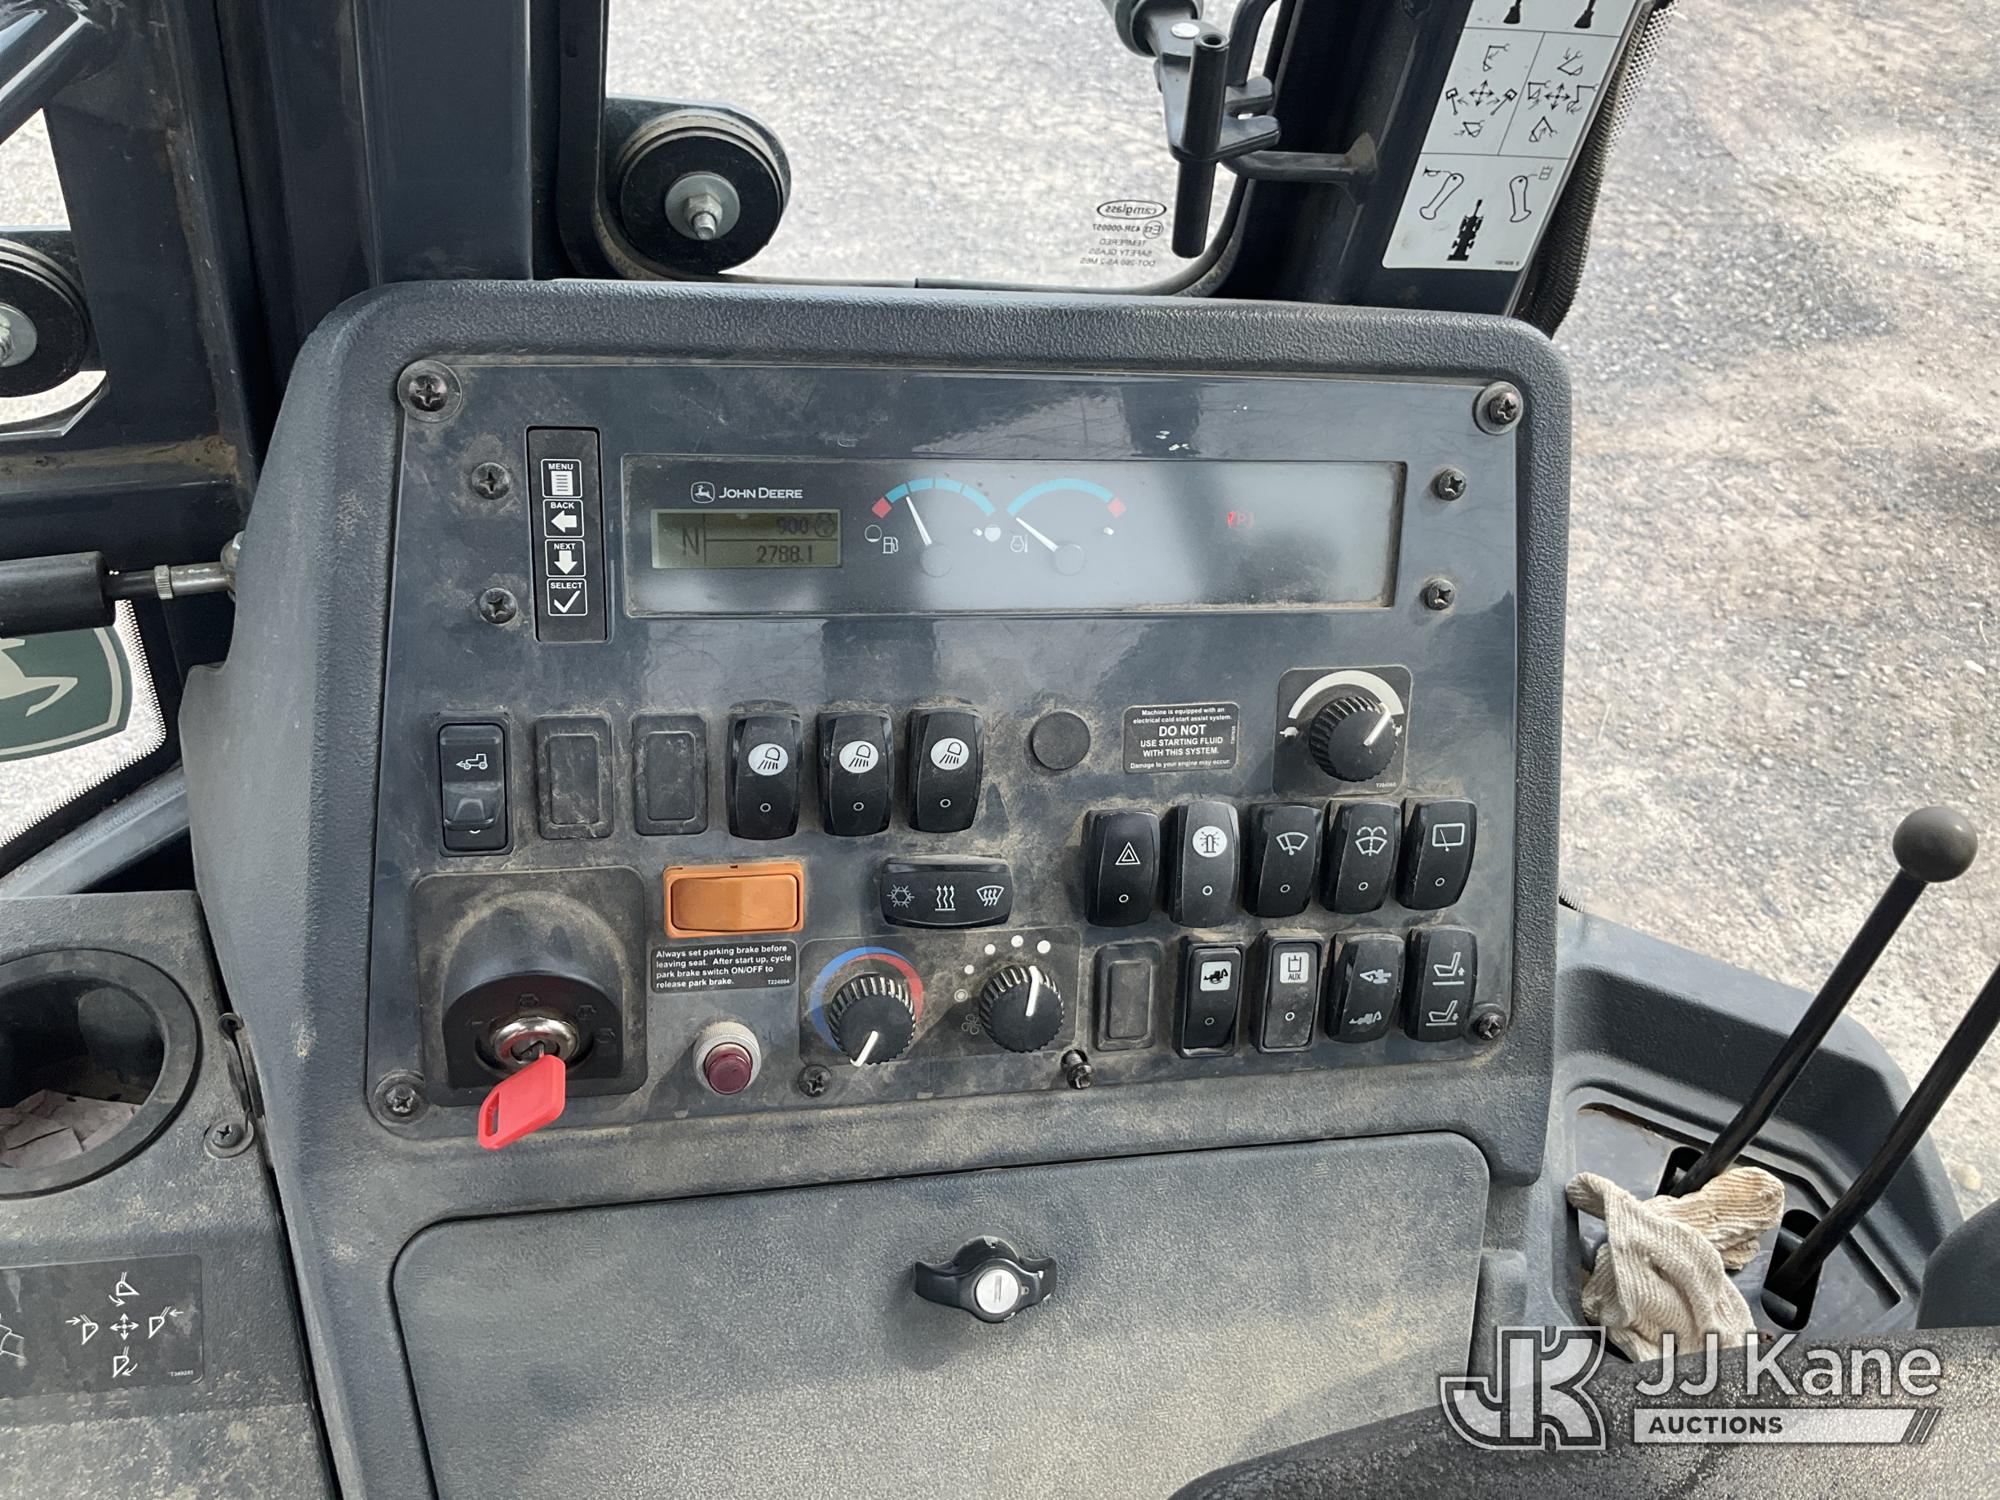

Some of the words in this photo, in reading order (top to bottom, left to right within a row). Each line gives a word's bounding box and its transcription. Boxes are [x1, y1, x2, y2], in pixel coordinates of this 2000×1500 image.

[718, 487, 758, 499] JOHN
[759, 487, 803, 499] DEERE
[682, 527, 699, 555] N
[756, 545, 813, 564] 2788.1
[1174, 708, 1202, 716] equipped
[1209, 714, 1232, 722] system.
[1158, 725, 1177, 737] DO
[1180, 724, 1207, 736] NOT
[1140, 740, 1157, 748] USE
[1158, 738, 1198, 747] STARTING
[1199, 736, 1223, 745] FLUID
[1142, 749, 1164, 757] WITH
[1165, 748, 1183, 756] THIS
[1185, 747, 1219, 755] SYSTEM.
[656, 950, 686, 959] Always
[688, 949, 702, 957] set
[703, 948, 734, 958] parking
[736, 946, 759, 954] brake
[761, 945, 787, 953] before
[656, 960, 687, 969] leaving
[688, 959, 708, 967] seat.
[712, 957, 733, 965] After
[756, 957, 769, 965] up,
[770, 954, 792, 963] cycle
[656, 970, 675, 979] park
[677, 969, 700, 977] brake
[702, 967, 729, 976] switch
[731, 966, 763, 975] ON/OFF
[765, 965, 774, 973] to
[1288, 973, 1301, 981] AUX
[656, 981, 686, 989] release
[688, 980, 707, 989] park
[709, 978, 734, 986] brake.
